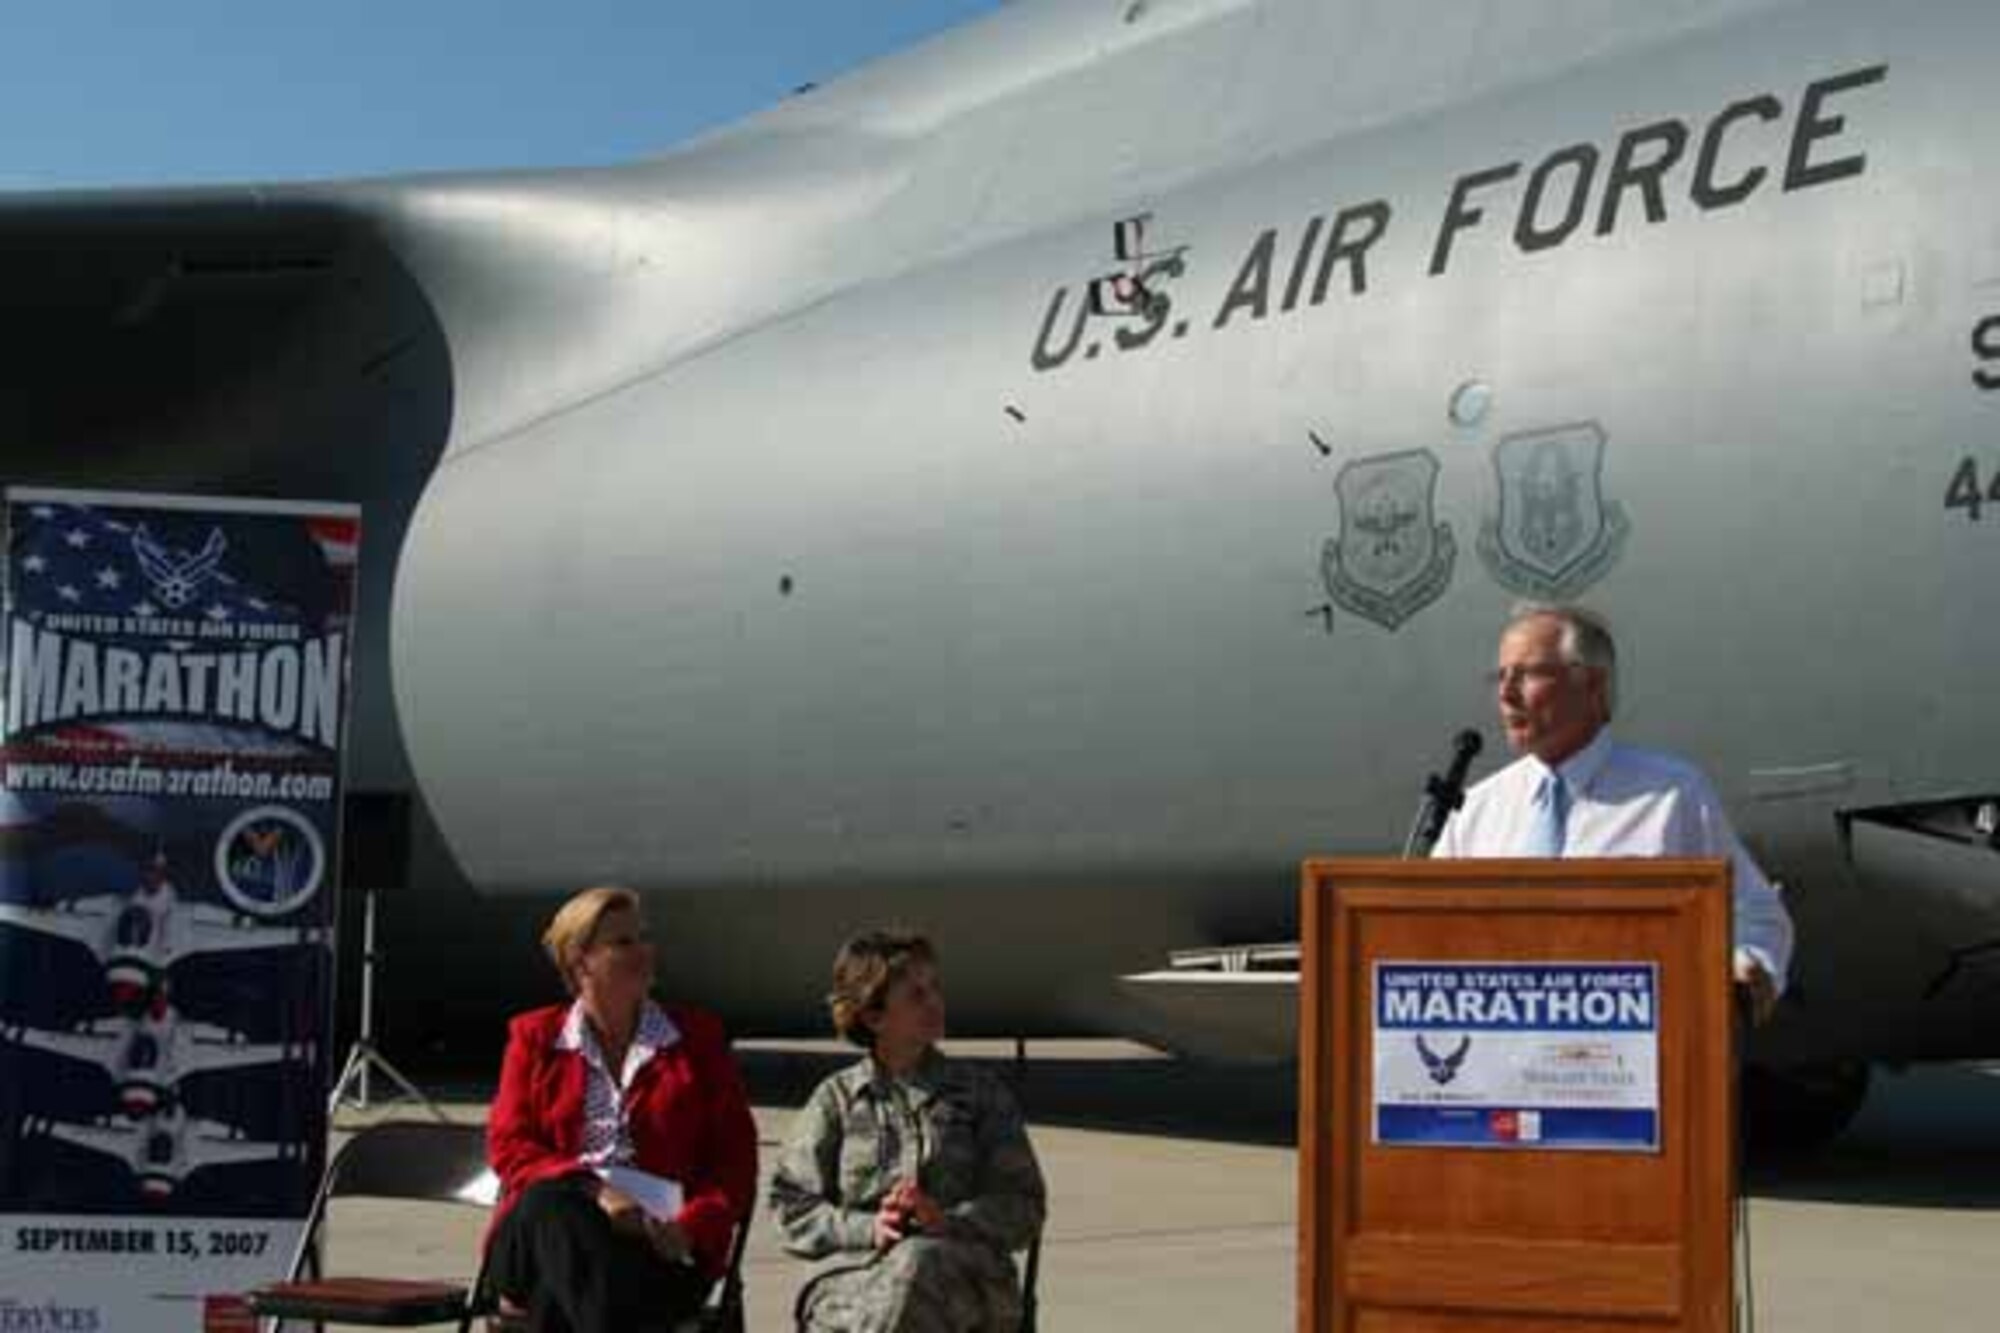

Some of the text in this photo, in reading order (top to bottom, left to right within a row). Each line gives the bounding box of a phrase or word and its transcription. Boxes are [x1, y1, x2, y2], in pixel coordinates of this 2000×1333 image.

[1213, 199, 1392, 330] AIR
[1428, 63, 1889, 277] FORCE
[7, 616, 342, 749] MARATHON
[1383, 971, 1646, 989] UNITED STATES AIR FORCE
[1383, 989, 1651, 1023] MARATHON
[16, 1227, 269, 1260] SEPTEMBER 15, 2007
